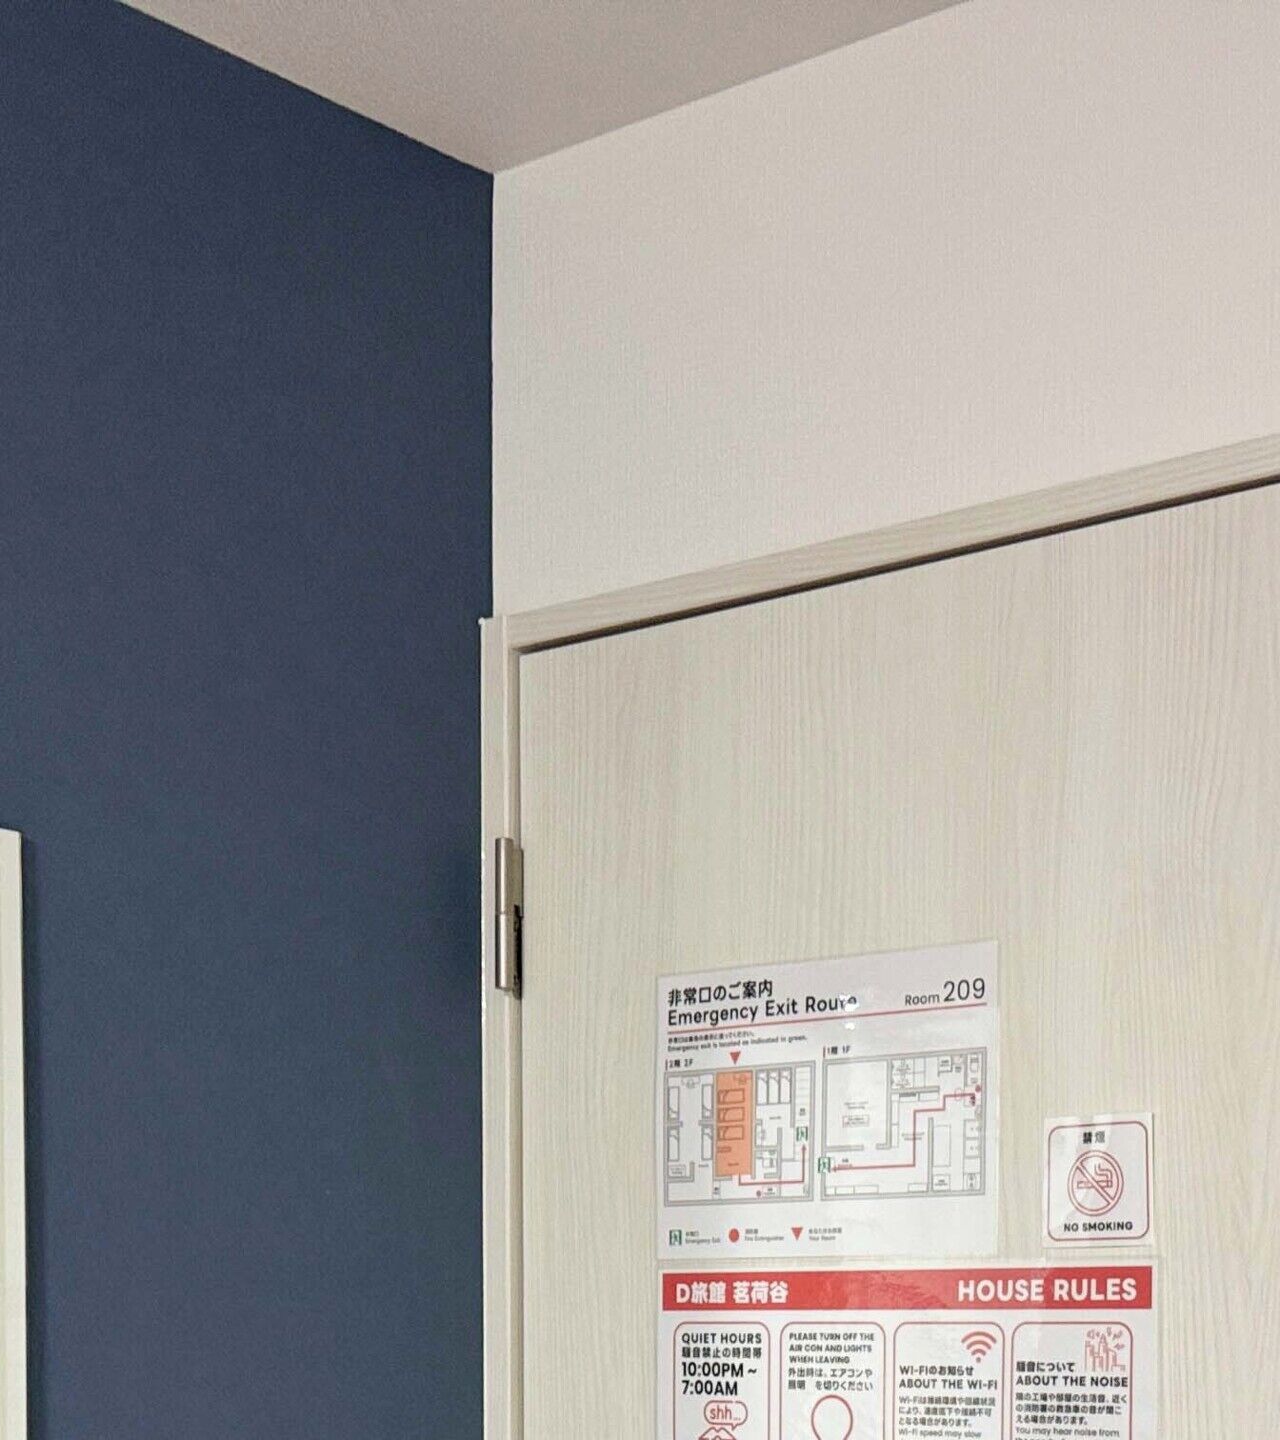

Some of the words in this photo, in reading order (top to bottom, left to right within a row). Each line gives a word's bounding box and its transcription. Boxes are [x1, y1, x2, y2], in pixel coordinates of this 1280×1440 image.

[668, 979, 773, 1007] 非常口のご案内
[905, 994, 940, 1006] Room
[943, 977, 985, 1002] 209
[668, 1005, 758, 1026] Emergency
[765, 999, 798, 1016] Exit
[1083, 1131, 1105, 1144] 禁煙
[1064, 1223, 1079, 1232] NO
[1082, 1222, 1133, 1232] SMOKING
[676, 1280, 726, 1304] D旅館
[733, 1280, 789, 1304] 茗荷谷
[957, 1279, 1045, 1302] HOUSE
[1053, 1277, 1137, 1301] RULES
[682, 1333, 716, 1345] QUIET
[721, 1333, 762, 1344] HOURS
[860, 1333, 874, 1341] THE
[682, 1346, 762, 1359] 騒音禁止の時間帯
[789, 1344, 802, 1352] AIR
[805, 1344, 822, 1352] CON
[844, 1345, 872, 1353] LIGHTS
[815, 1356, 850, 1364] LEAVING
[682, 1362, 744, 1378] 10:00PM
[788, 1367, 872, 1378] 外出時は、エアコンや
[899, 1365, 974, 1376] WI-FIのお知らせ
[1016, 1361, 1076, 1372] 騒音について
[899, 1379, 937, 1389] ABOUT
[941, 1379, 963, 1389] THE
[967, 1379, 998, 1390] WI-FI
[1016, 1375, 1059, 1386] ABOUT
[1062, 1376, 1086, 1386] THE
[1090, 1376, 1128, 1388] NOISE
[682, 1380, 738, 1396] 7:00AM
[920, 1429, 943, 1438] speed
[945, 1431, 962, 1439] may
[964, 1430, 982, 1438] slow
[1032, 1429, 1051, 1437] may
[1099, 1429, 1120, 1437] from
